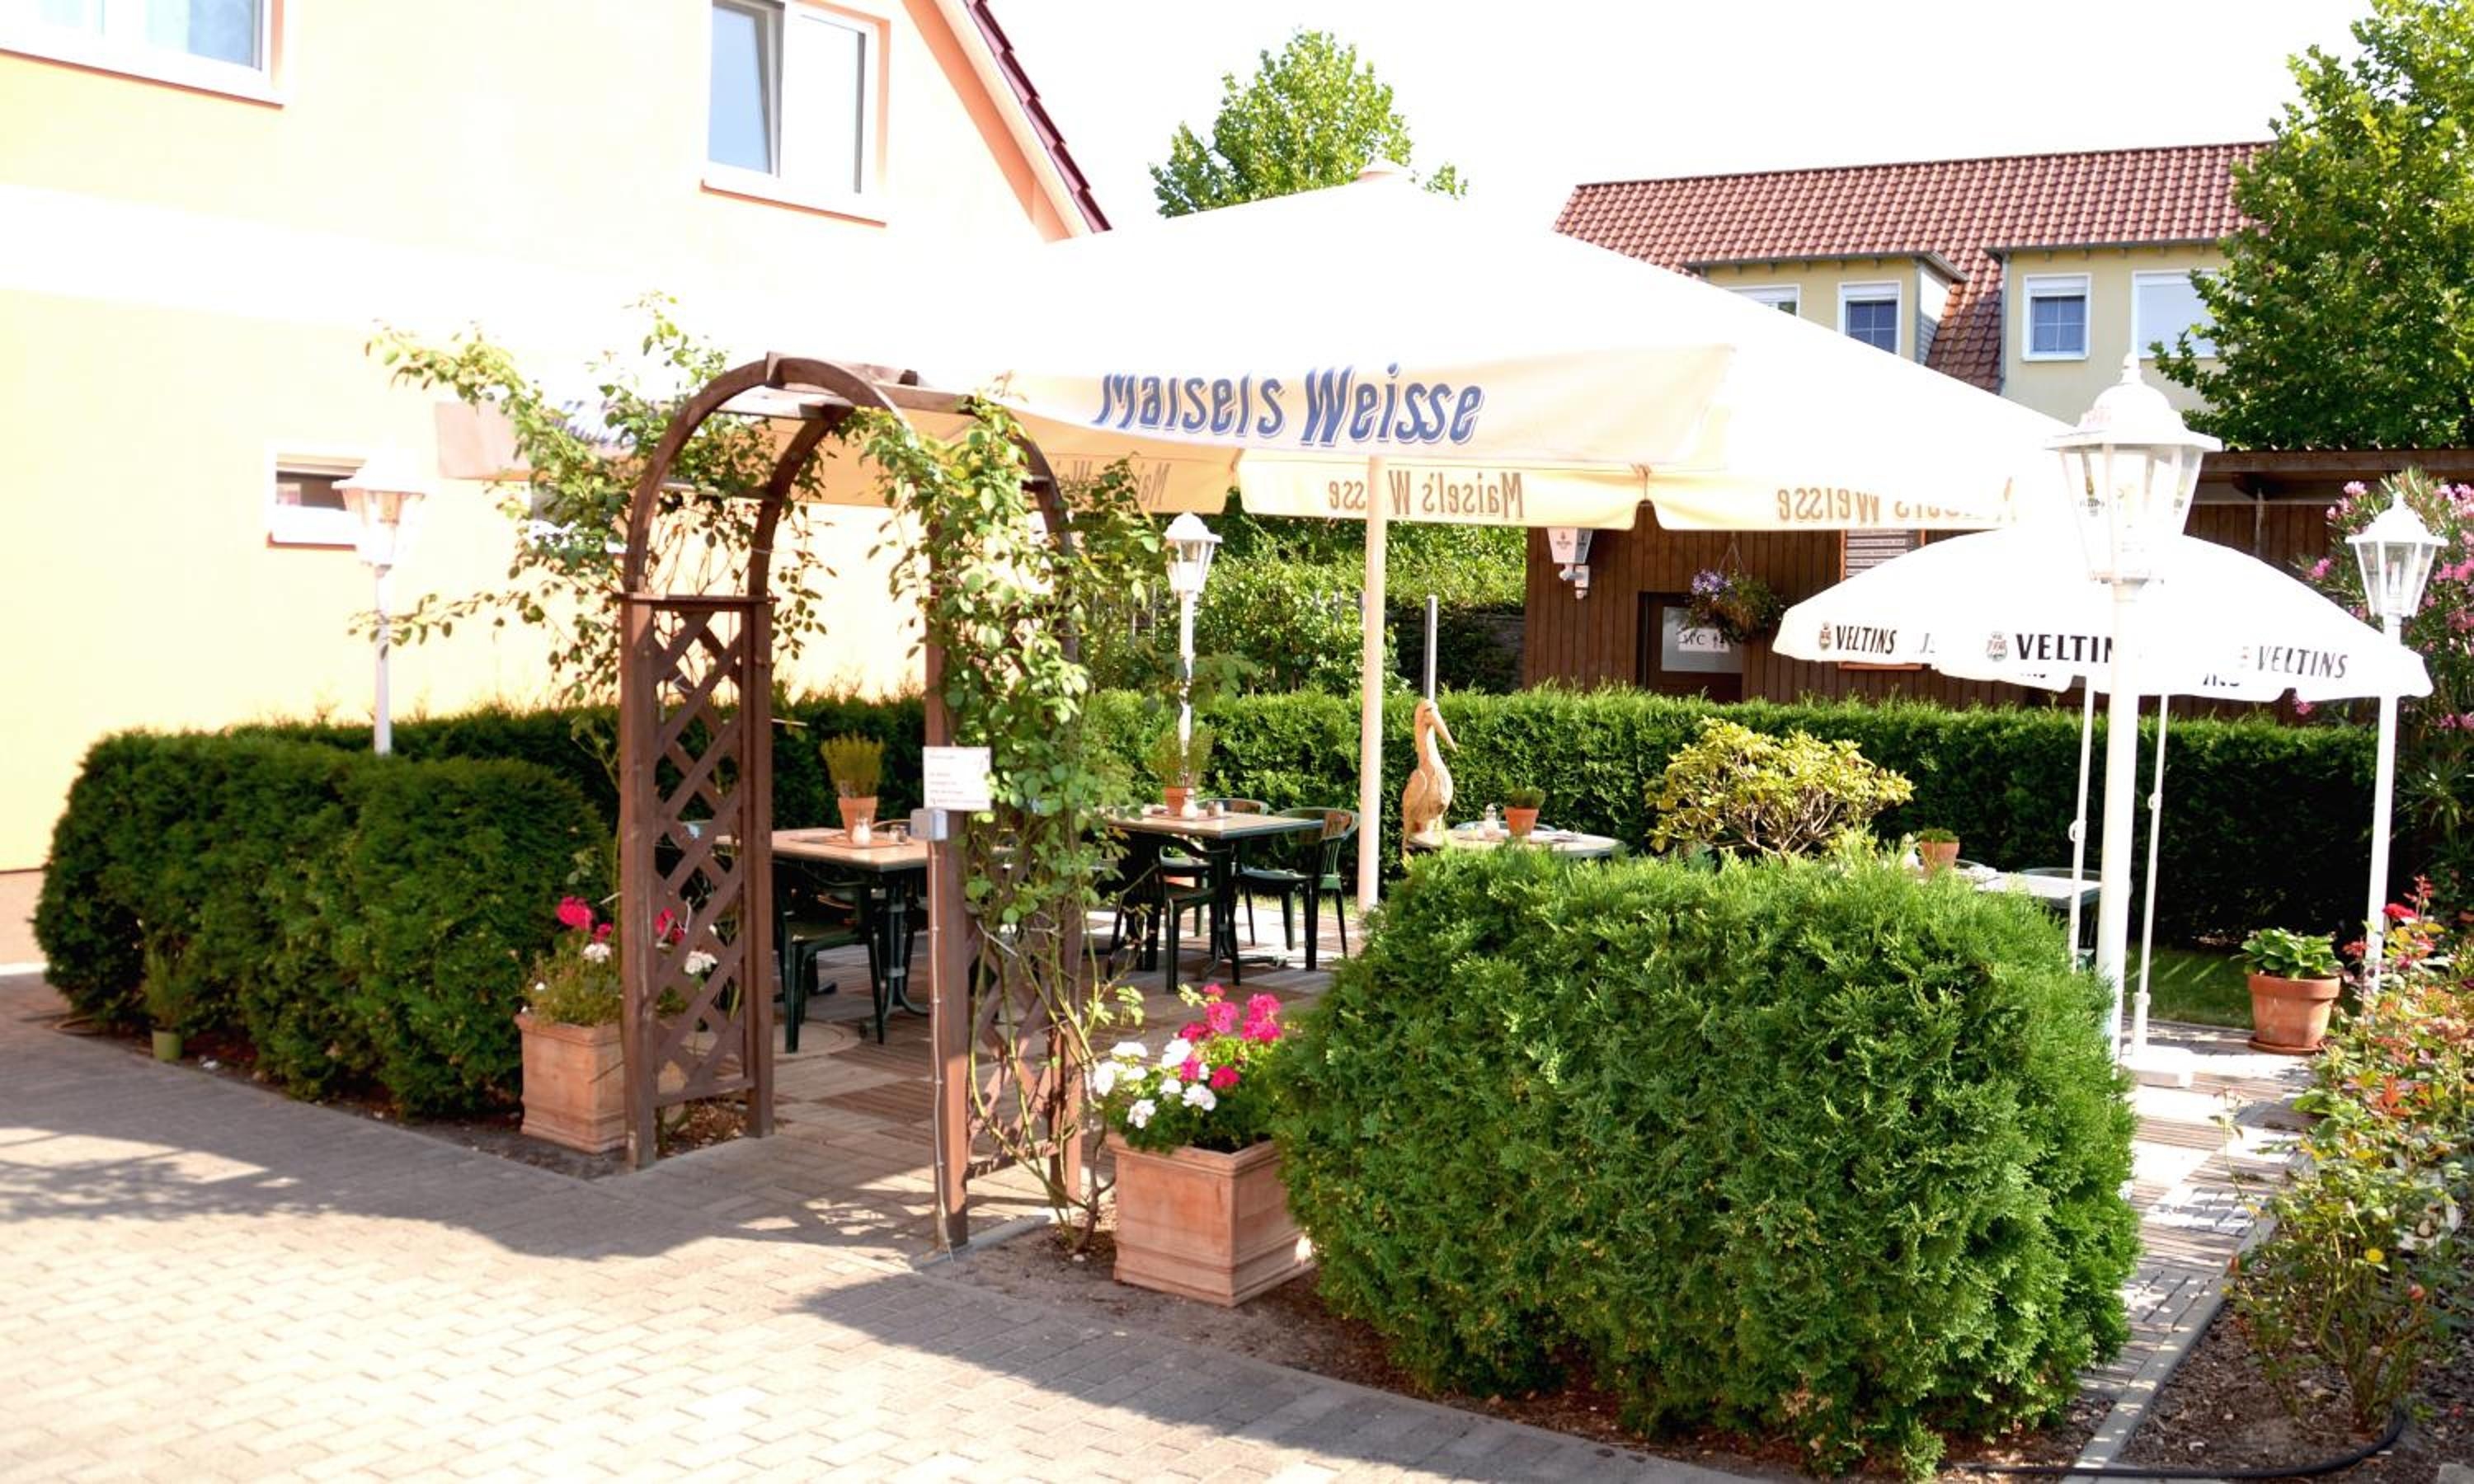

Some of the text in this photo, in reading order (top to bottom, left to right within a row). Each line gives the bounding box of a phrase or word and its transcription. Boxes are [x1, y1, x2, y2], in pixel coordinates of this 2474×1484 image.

[1300, 363, 1484, 447] Weisse
[1836, 625, 1898, 655] VELTINS
[2257, 646, 2348, 679] VELTINS
